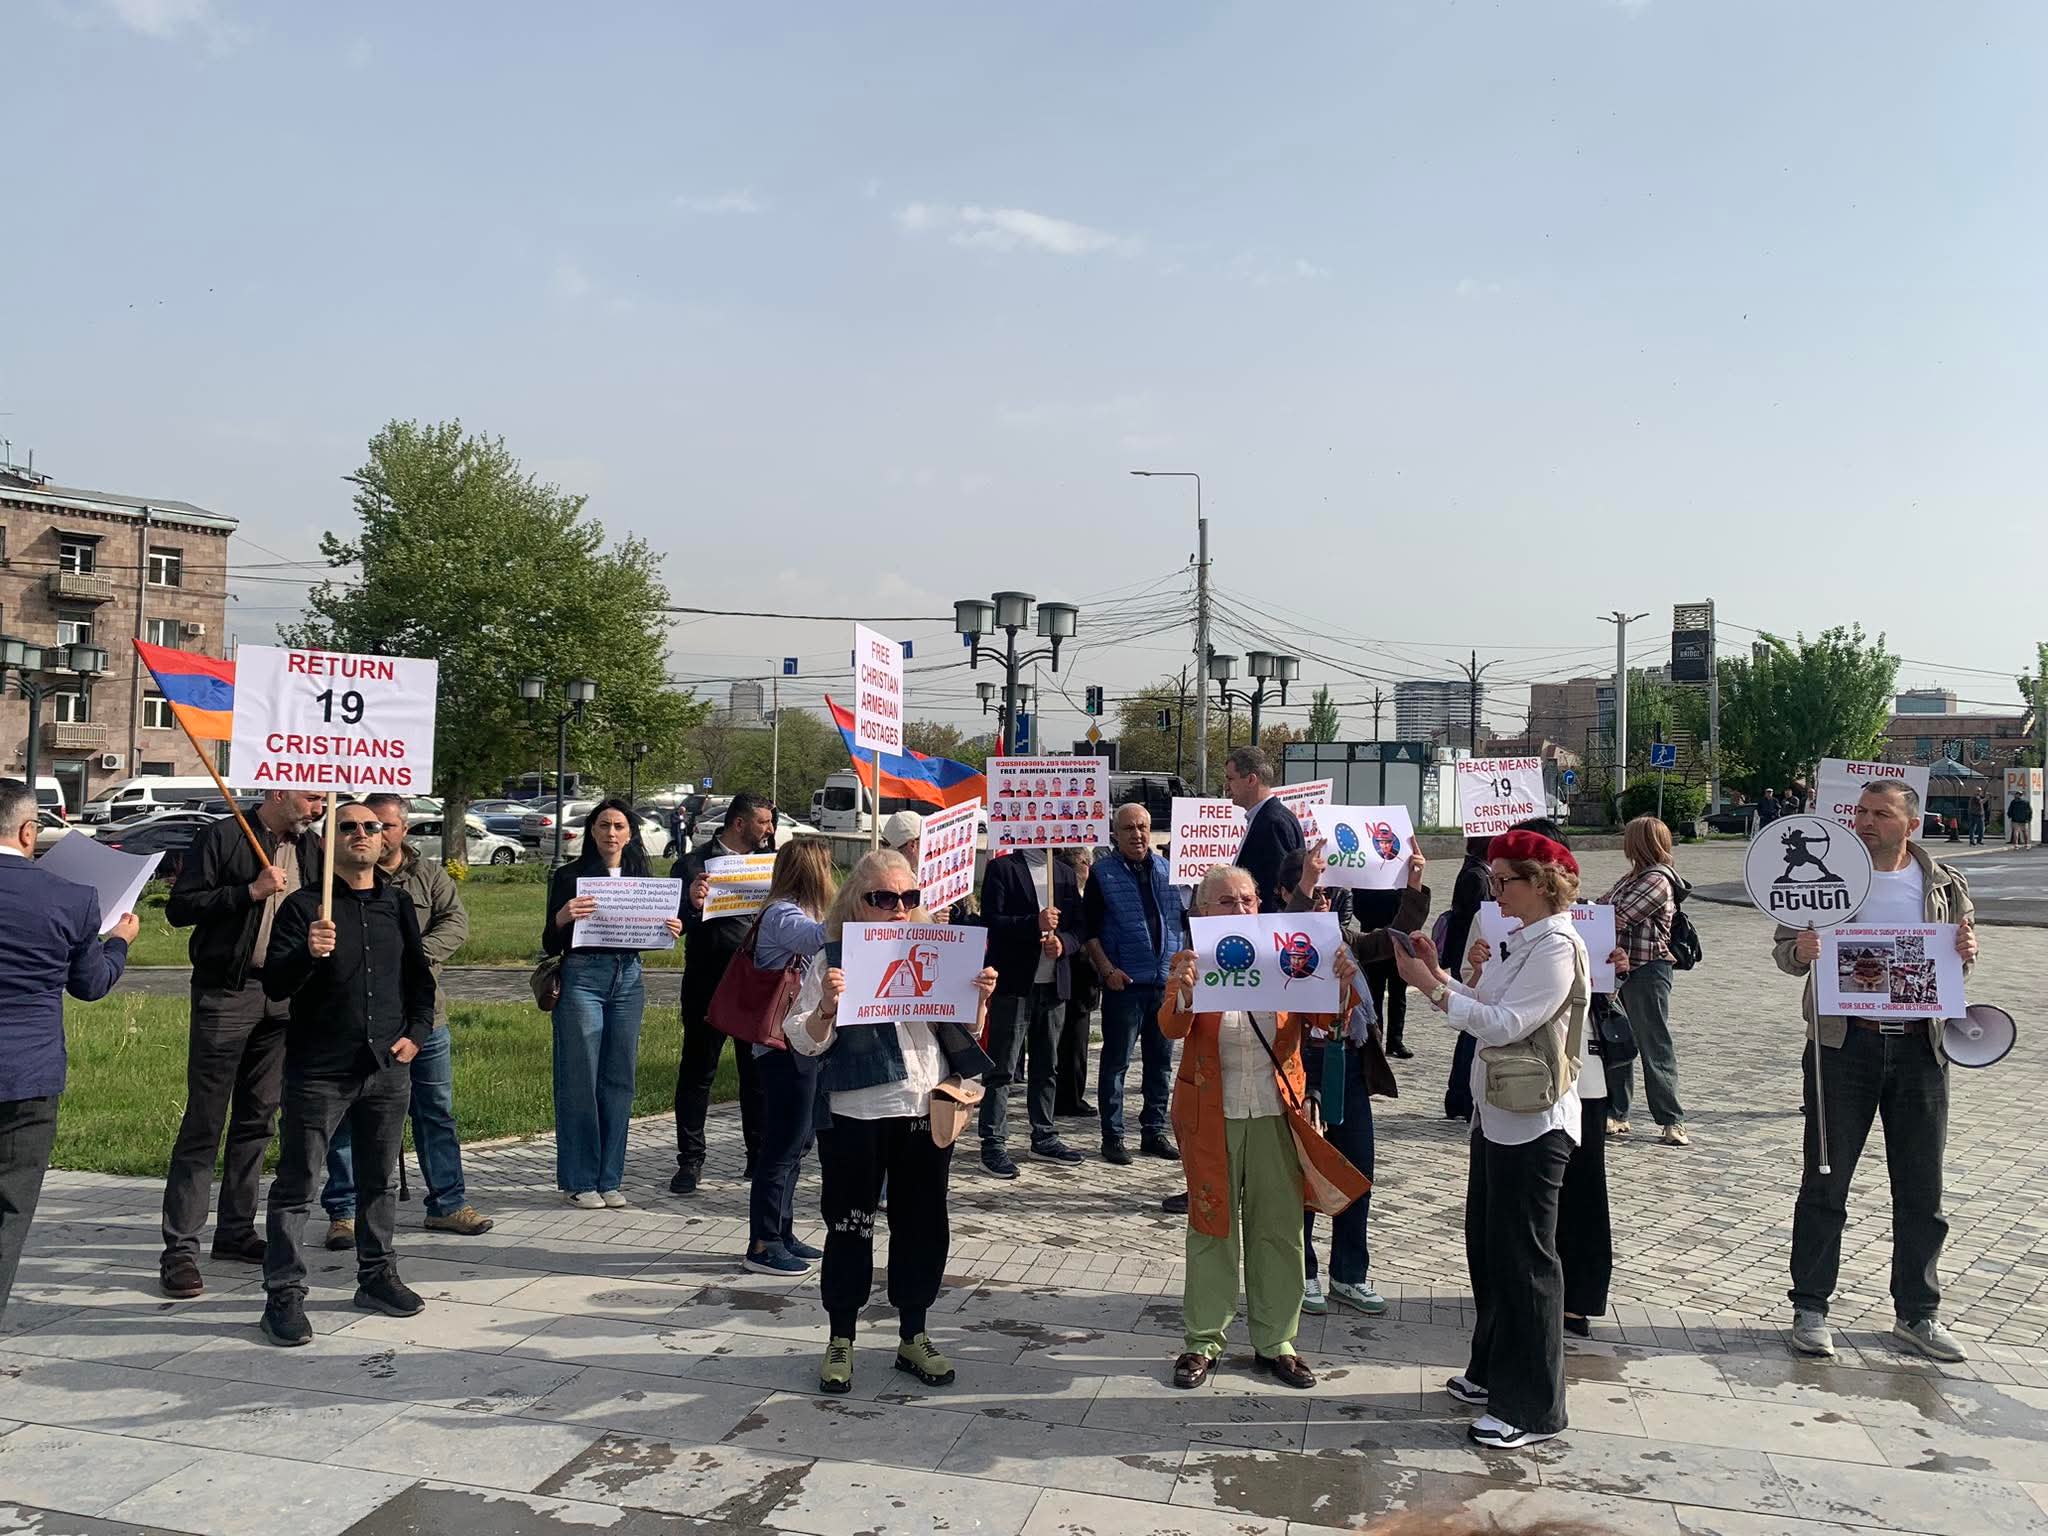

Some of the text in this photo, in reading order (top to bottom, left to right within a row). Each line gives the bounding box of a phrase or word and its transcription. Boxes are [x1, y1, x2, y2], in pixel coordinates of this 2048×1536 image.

[872, 641, 890, 665] FREE
[288, 653, 394, 680] RETURN
[861, 663, 899, 695] CHRISTIAN
[316, 688, 365, 724] 19
[861, 691, 899, 720] ARMENIAN
[860, 718, 899, 746] HOSTAGES
[266, 733, 406, 758] CRISTIANS
[254, 762, 412, 786] ARMENIANS
[1458, 758, 1538, 774] PEACE MEANS
[1846, 763, 1905, 778] RETURN
[1490, 777, 1512, 798] 19
[2007, 772, 2028, 789] P4
[1199, 805, 1232, 819] FREE
[1474, 802, 1534, 818] CRISTIANS
[1180, 824, 1247, 838] CHRISTIAN
[1365, 822, 1392, 840] NO
[1464, 820, 1511, 834] RETURN
[1179, 844, 1239, 858] ARMENIA
[1338, 852, 1366, 868] YES
[1770, 888, 1852, 911] ԲԵՎԵՌ
[864, 928, 966, 943] ԱՐՑԱԽԸ ՀԱՅԱՍՏԱՆ Է
[1274, 932, 1312, 952] NO
[1218, 968, 1260, 988] YES
[857, 1004, 956, 1018] ARTSAKH IS ARMENIA
[1838, 1002, 1852, 1010] YOUR
[1854, 1002, 1876, 1010] SILENCE
[1882, 1003, 1904, 1011] CHURCH
[1905, 1004, 1942, 1012] DESTRUCTION
